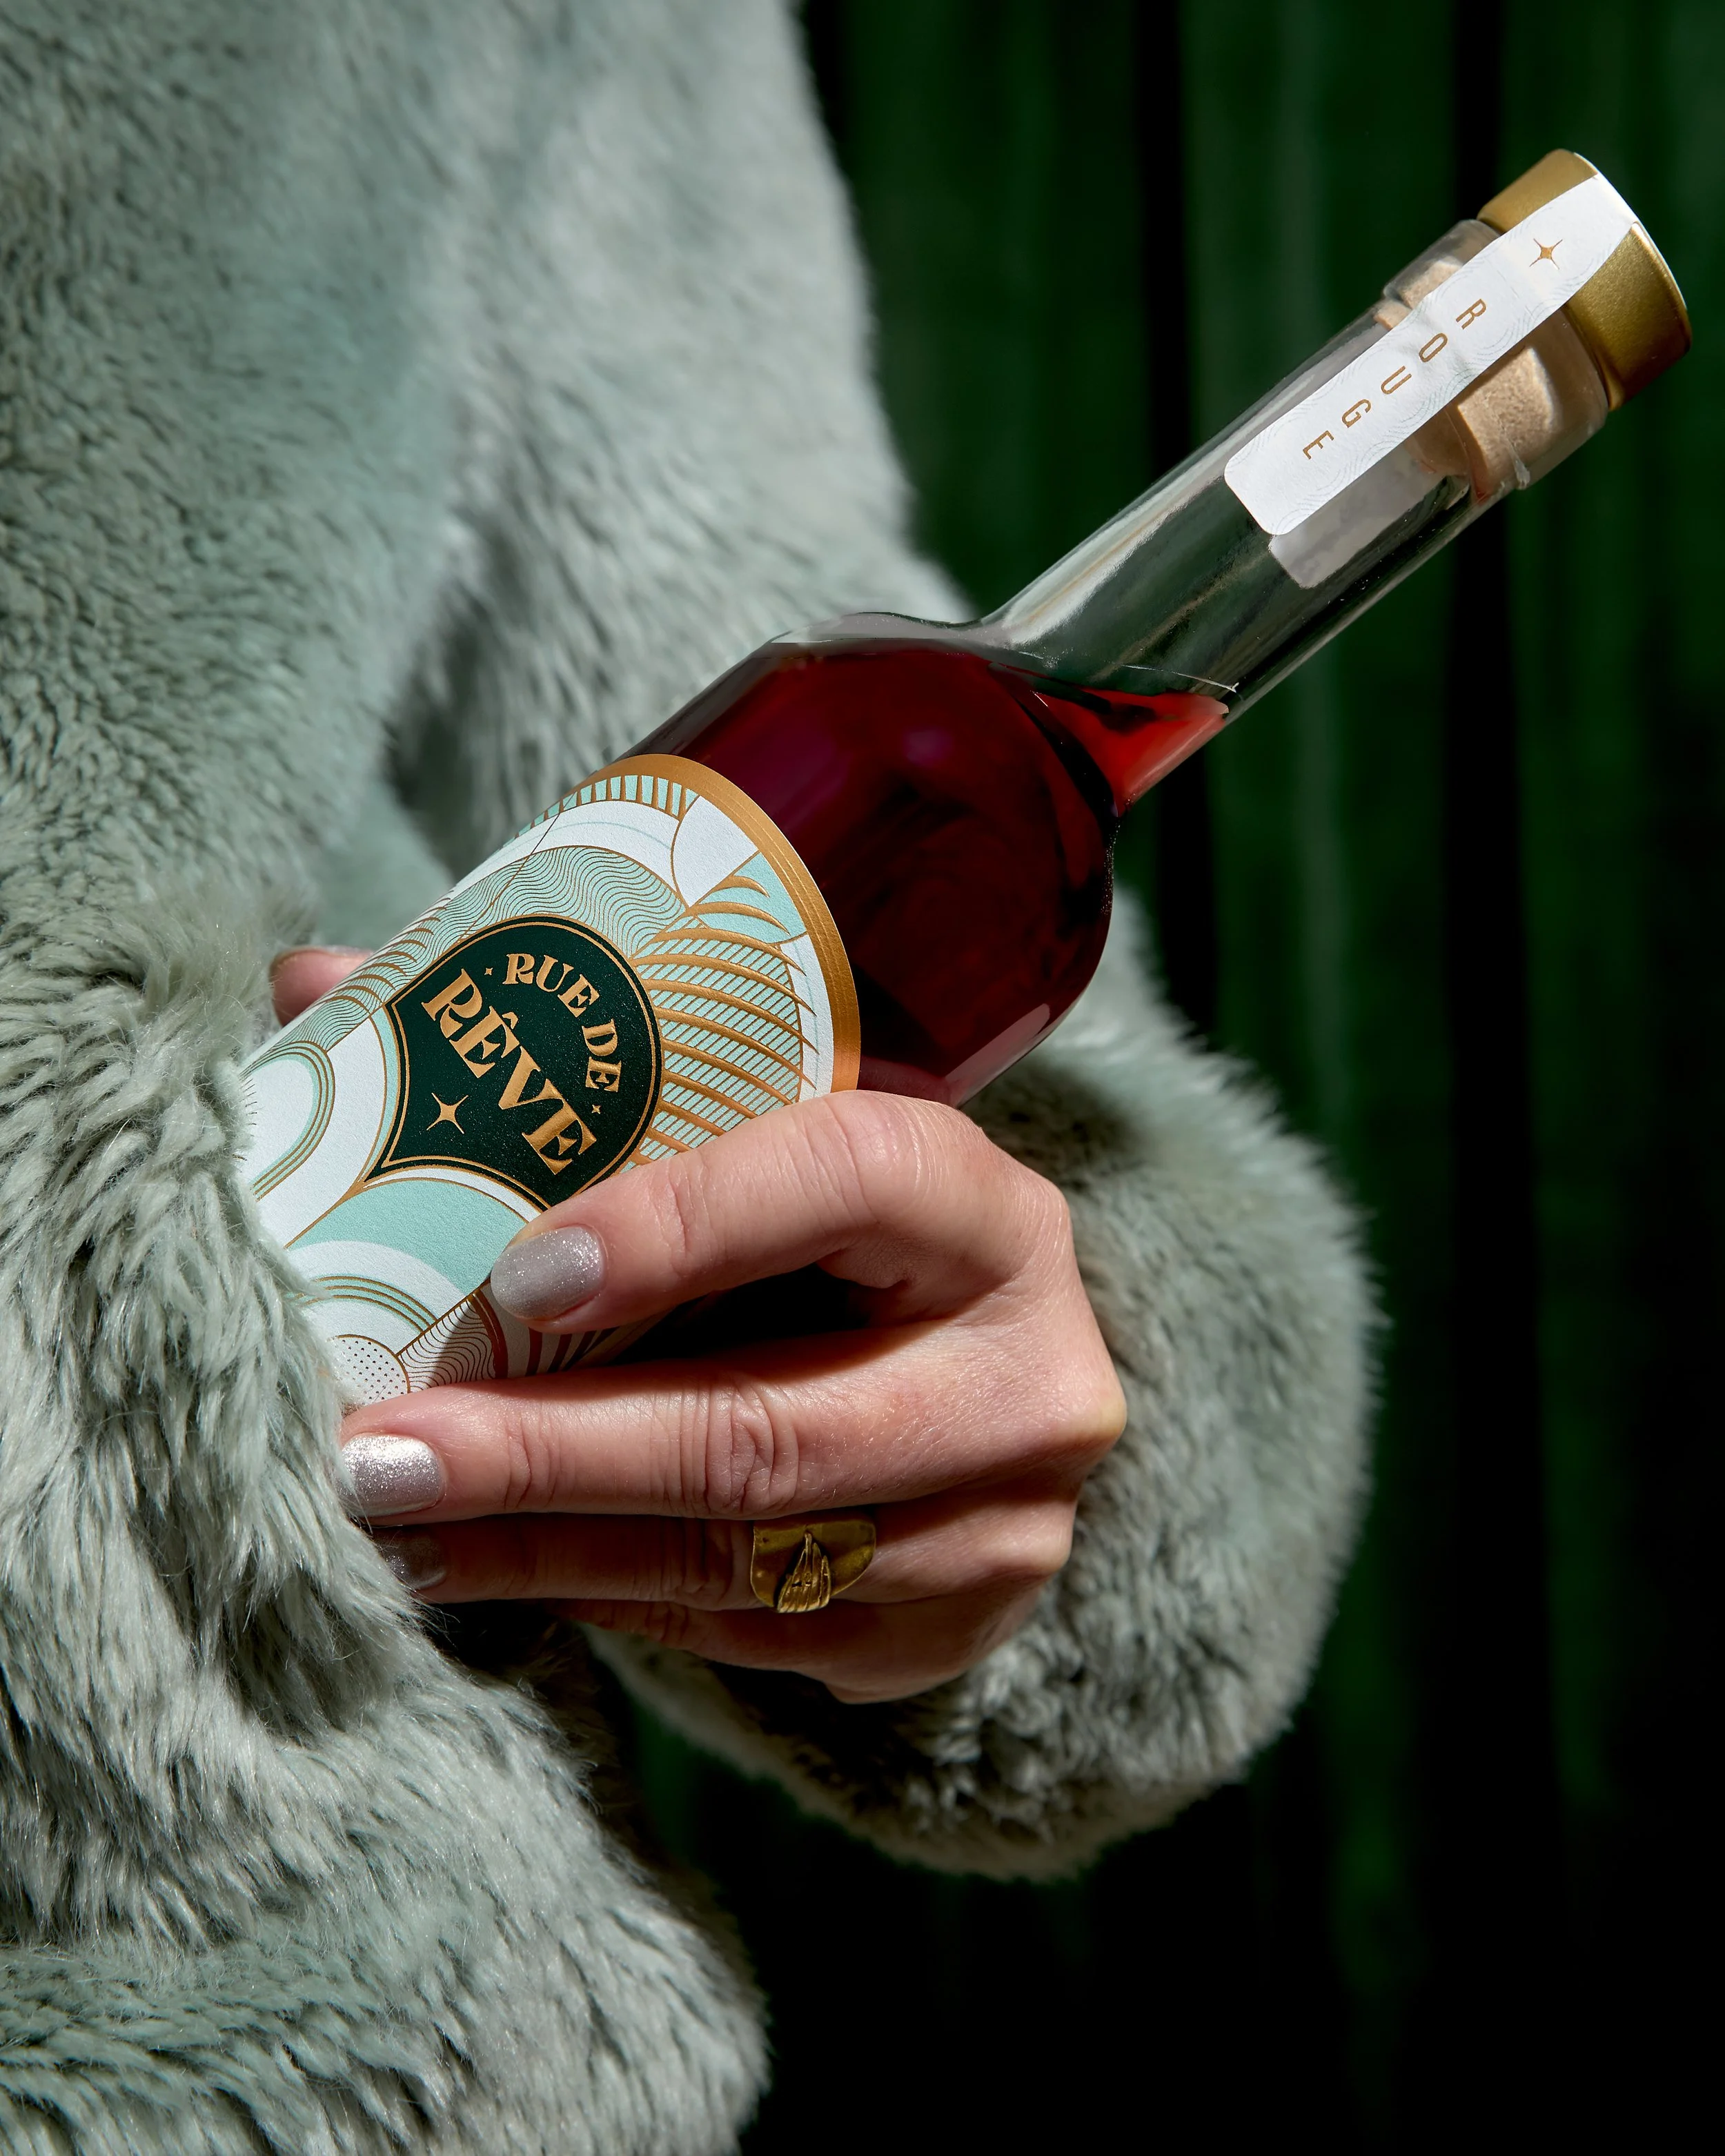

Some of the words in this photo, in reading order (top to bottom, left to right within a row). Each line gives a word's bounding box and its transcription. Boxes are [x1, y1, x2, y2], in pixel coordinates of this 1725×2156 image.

[1302, 299, 1487, 460] ROUGE
[421, 968, 598, 1176] RÊVE
[502, 953, 600, 1018] RUE
[582, 1018, 622, 1093] DE
